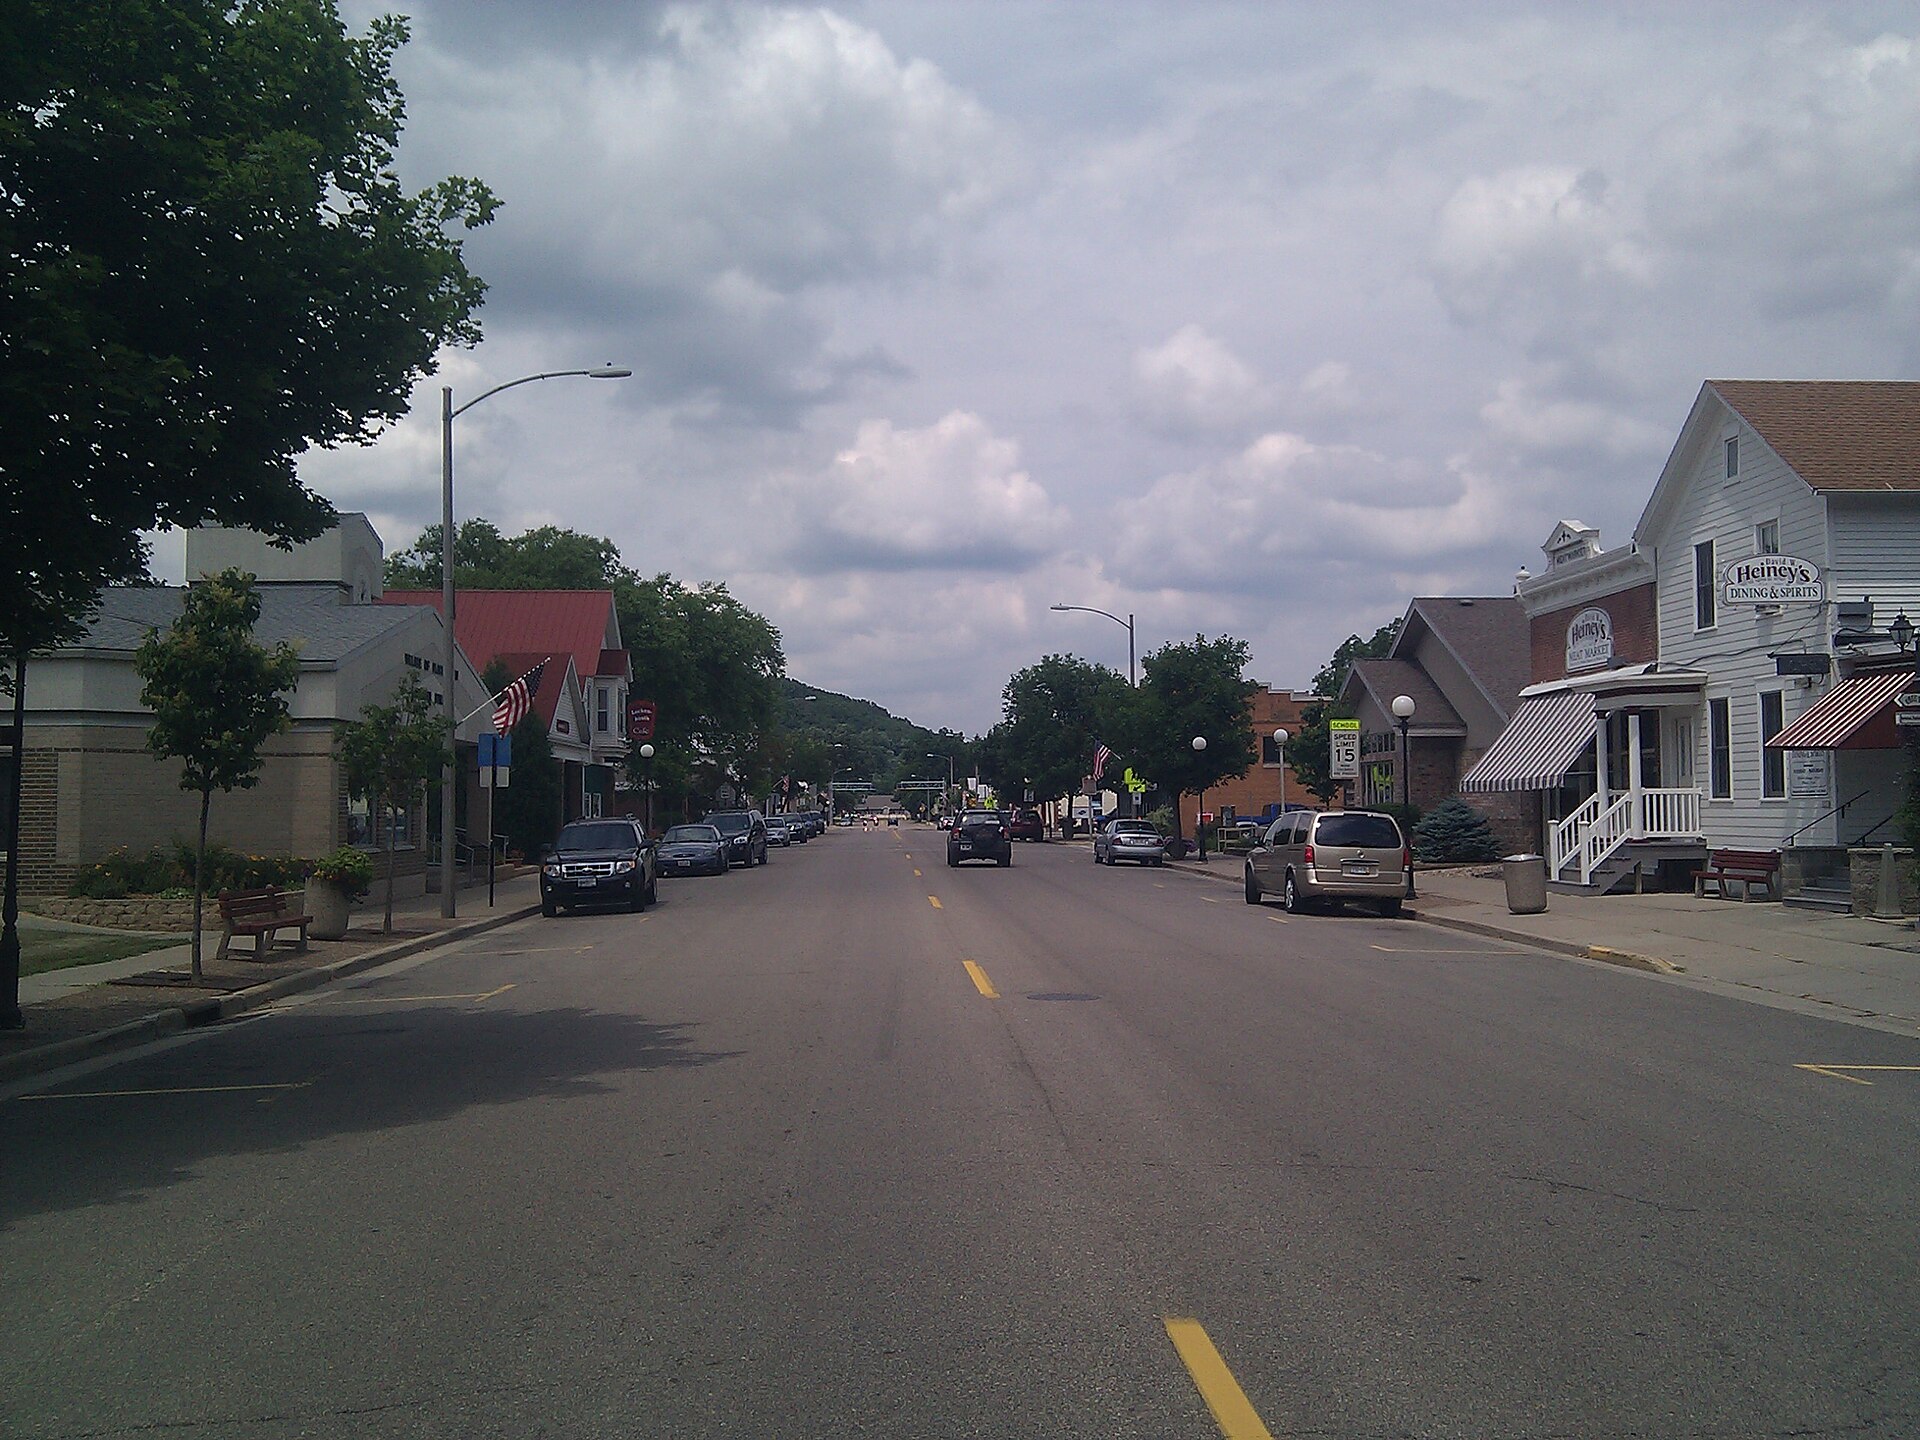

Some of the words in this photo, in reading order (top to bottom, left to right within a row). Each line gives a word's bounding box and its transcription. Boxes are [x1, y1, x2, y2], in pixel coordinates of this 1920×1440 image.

[1737, 562, 1810, 584] Heiney's
[1731, 588, 1768, 598] DINING
[1770, 586, 1779, 599] &
[1780, 587, 1818, 598] SPIRITS
[1571, 619, 1606, 645] Heiney's
[1584, 644, 1608, 658] MARKET
[1336, 749, 1355, 762] 15
